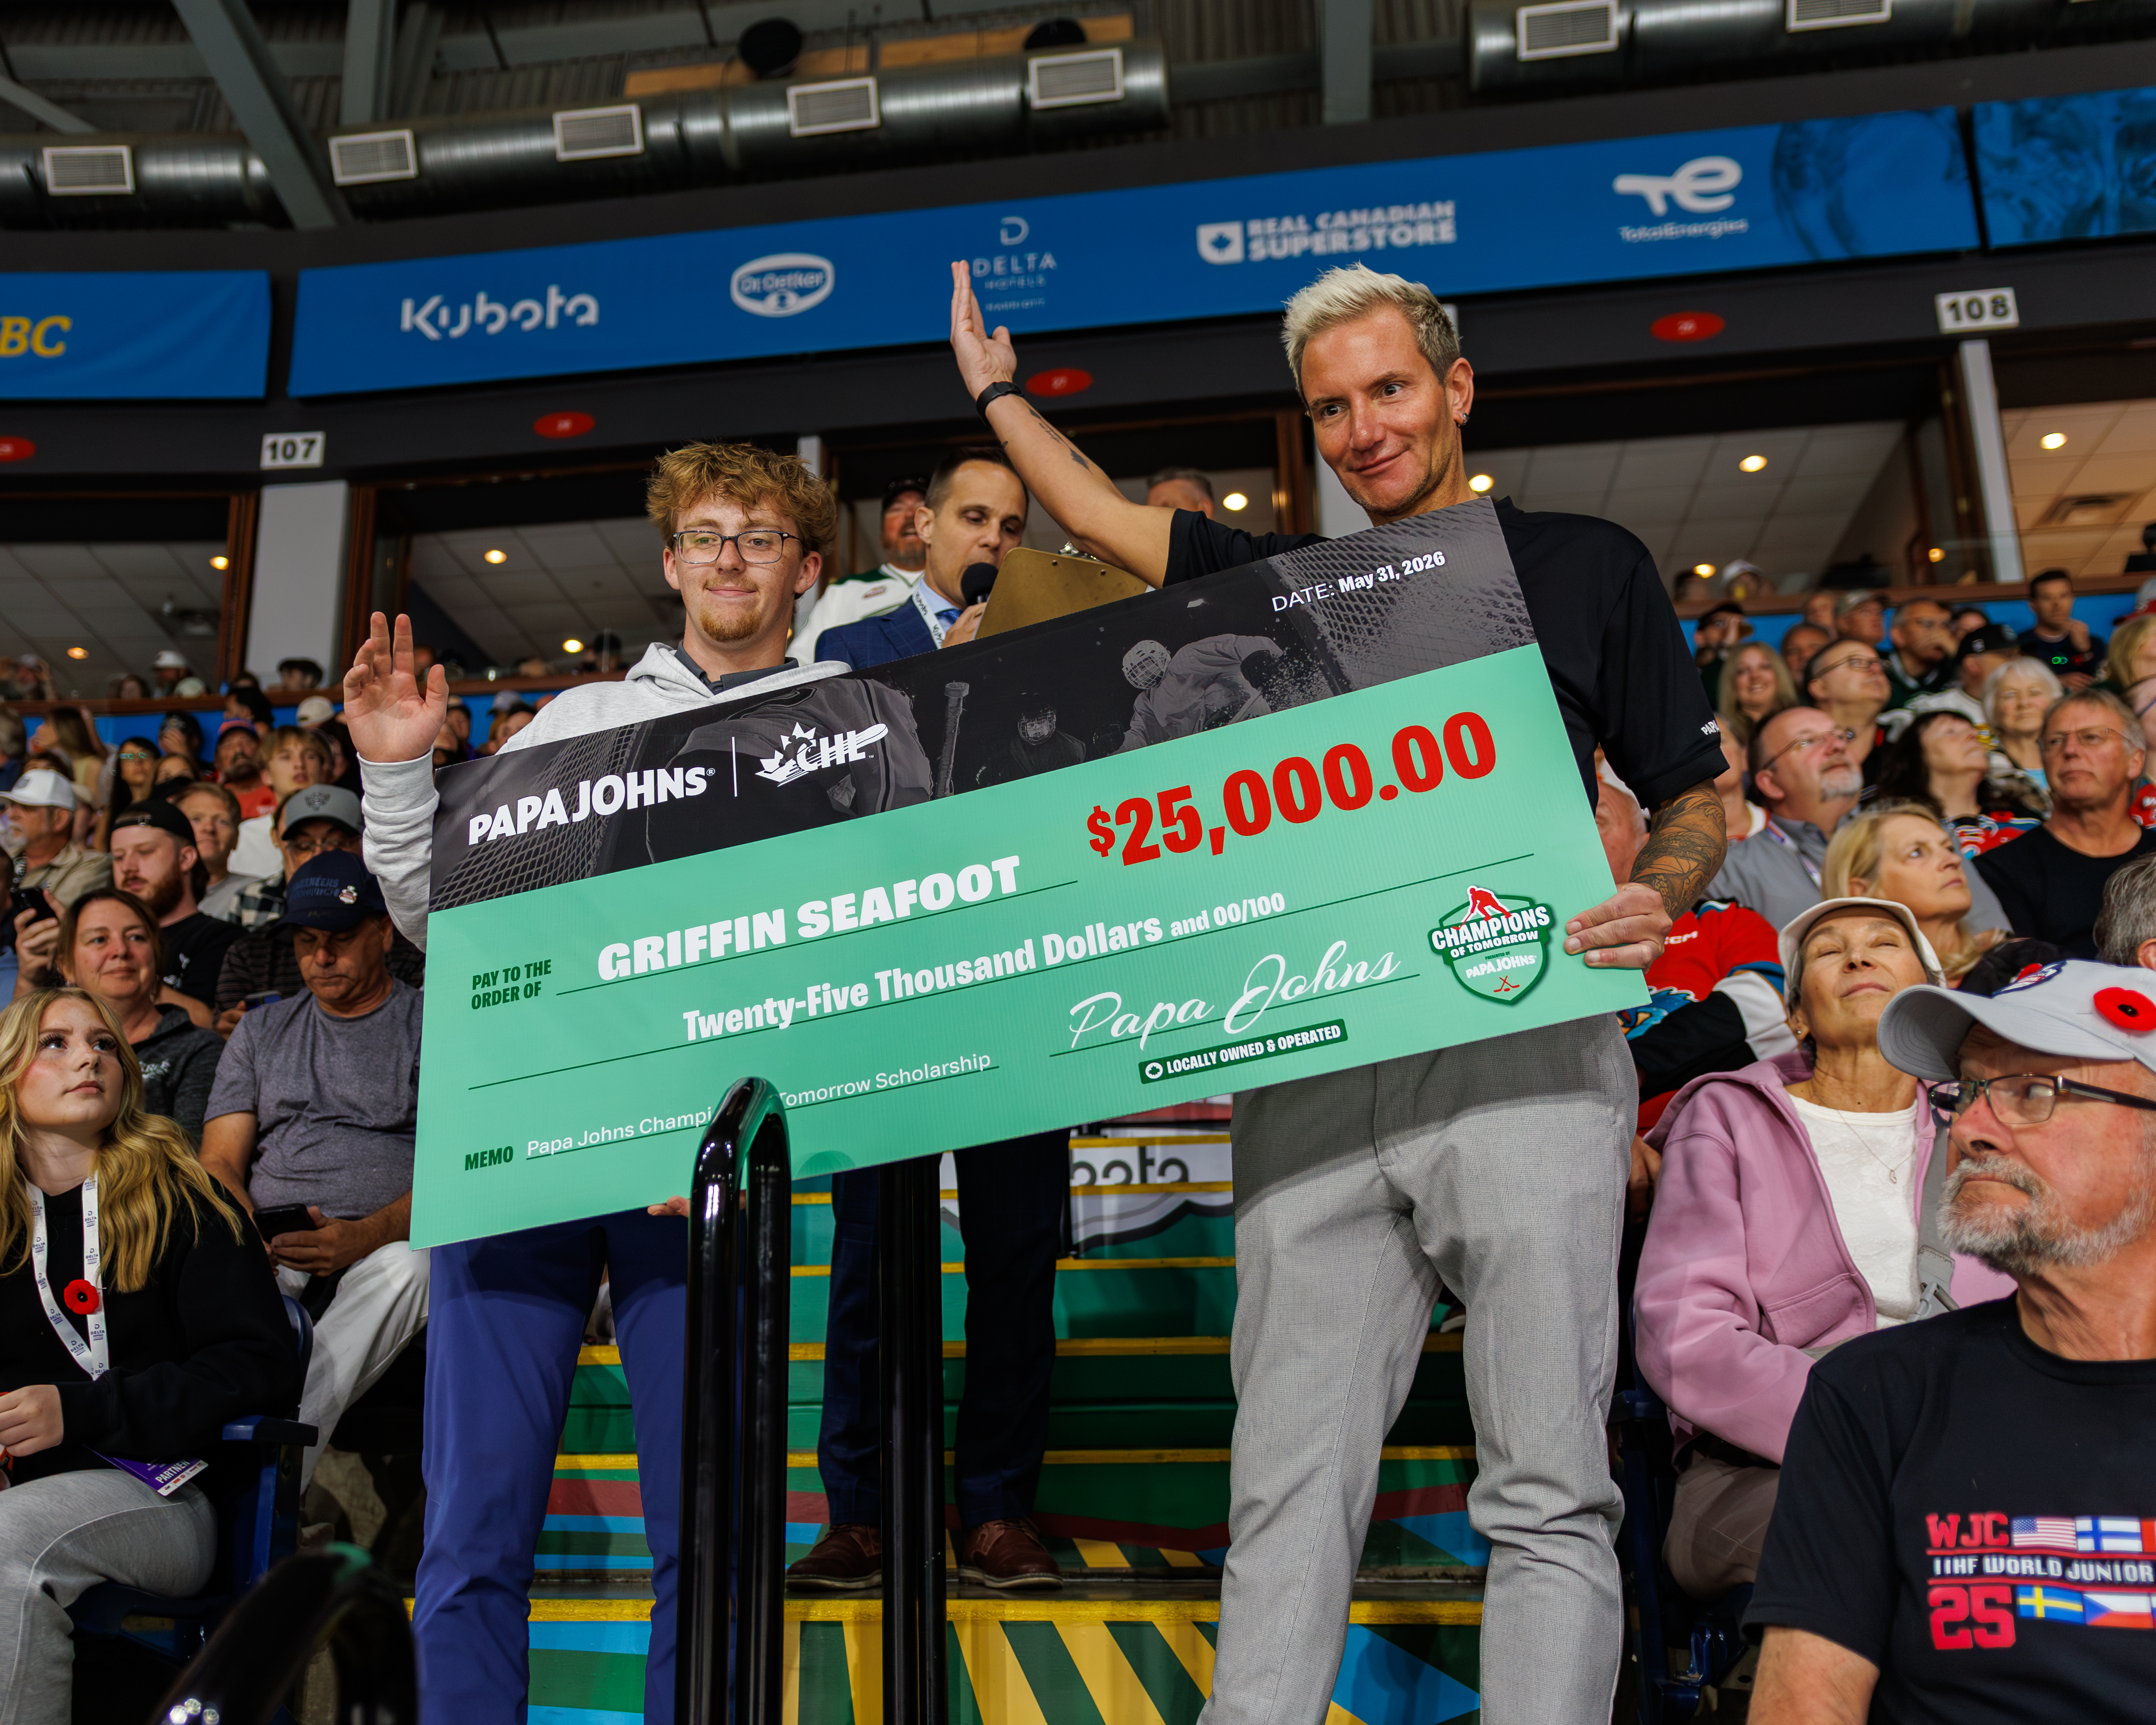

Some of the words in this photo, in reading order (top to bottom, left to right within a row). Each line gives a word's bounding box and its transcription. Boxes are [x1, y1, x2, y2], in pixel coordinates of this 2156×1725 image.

[1247, 214, 1310, 237] REAL
[1315, 200, 1456, 230] CANADIAN
[1248, 218, 1457, 261] SUPERSTORE
[972, 252, 1058, 278] DELTA
[400, 285, 599, 341] Kubota
[1947, 295, 2009, 322] 108
[267, 437, 316, 461] 107
[1272, 583, 1335, 612] DATE:
[1337, 573, 1374, 593] May
[1376, 564, 1400, 583] 31,
[1401, 551, 1446, 576] 2026
[1087, 711, 1496, 867] $25,000.00
[597, 908, 786, 982] GRIFFIN
[796, 855, 1020, 939] SEAFOOT
[1431, 906, 1550, 950] CHAMPIONS
[1450, 946, 1466, 959] OF
[1466, 930, 1539, 953] TOMORROW
[472, 970, 499, 990] PAY
[502, 966, 521, 983] TO
[524, 960, 551, 978] THE
[683, 982, 870, 1042] Twenty-Five
[875, 937, 1035, 998] Thousand
[1043, 917, 1163, 966] Dollars
[1171, 910, 1209, 937] and
[1213, 891, 1286, 927] 00/100
[472, 986, 520, 1009] ORDER
[524, 981, 542, 999] OF
[1069, 991, 1215, 1052] Papa
[1223, 940, 1401, 1034] Johns
[1166, 1051, 1217, 1074] LOCALLY
[1219, 1041, 1264, 1063] OWNED
[1266, 1038, 1275, 1053] &
[1277, 1024, 1341, 1050] OPERATED
[465, 1146, 514, 1171] MEMO
[527, 1138, 573, 1156] Papa
[577, 1123, 635, 1147] Johns
[779, 1076, 871, 1107] Tomorrow
[875, 1052, 992, 1091] Scholarship
[70, 1343, 84, 1353] DELTA
[155, 1460, 191, 1484] PARTNER
[1926, 1511, 2010, 1548] WJC
[1934, 1556, 1978, 1576] IIHF
[1982, 1555, 2062, 1577] WORLD
[2064, 1559, 2154, 1582] JUNIOR
[1928, 1586, 2016, 1650] 25
